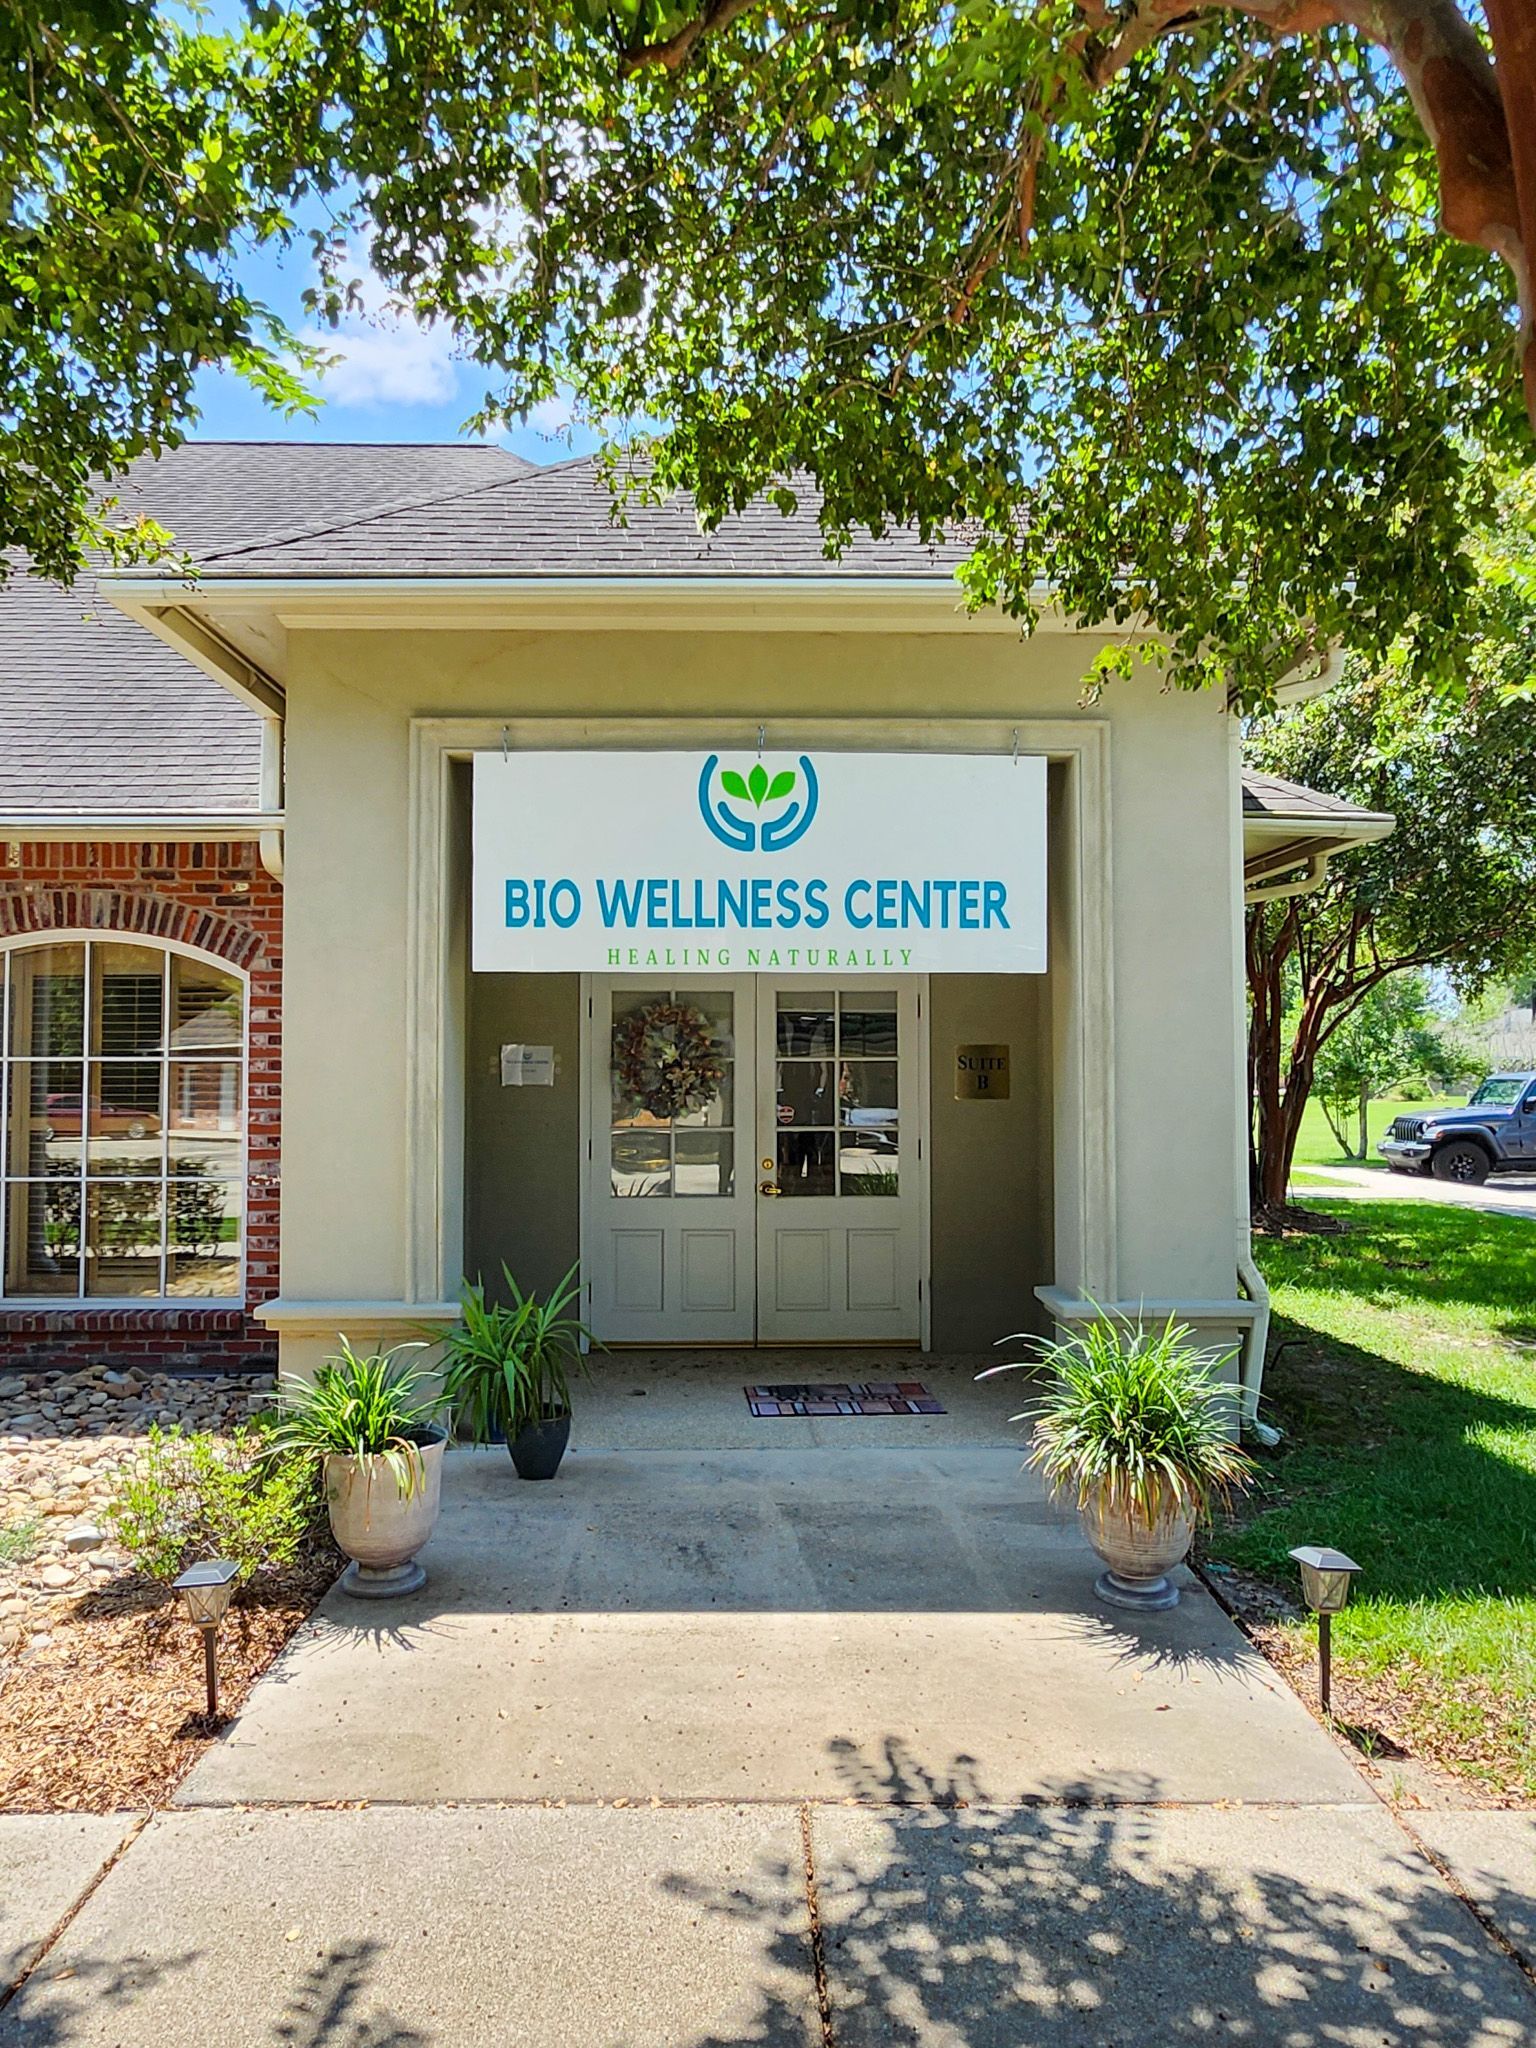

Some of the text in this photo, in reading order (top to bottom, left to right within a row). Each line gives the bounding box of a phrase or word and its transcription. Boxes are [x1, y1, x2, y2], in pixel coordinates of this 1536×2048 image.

[505, 878, 1011, 929] BIO WELLNESS CENTER
[608, 948, 913, 965] HEALING NATURALLY
[957, 1054, 1006, 1070] SUITE
[977, 1074, 989, 1090] B
